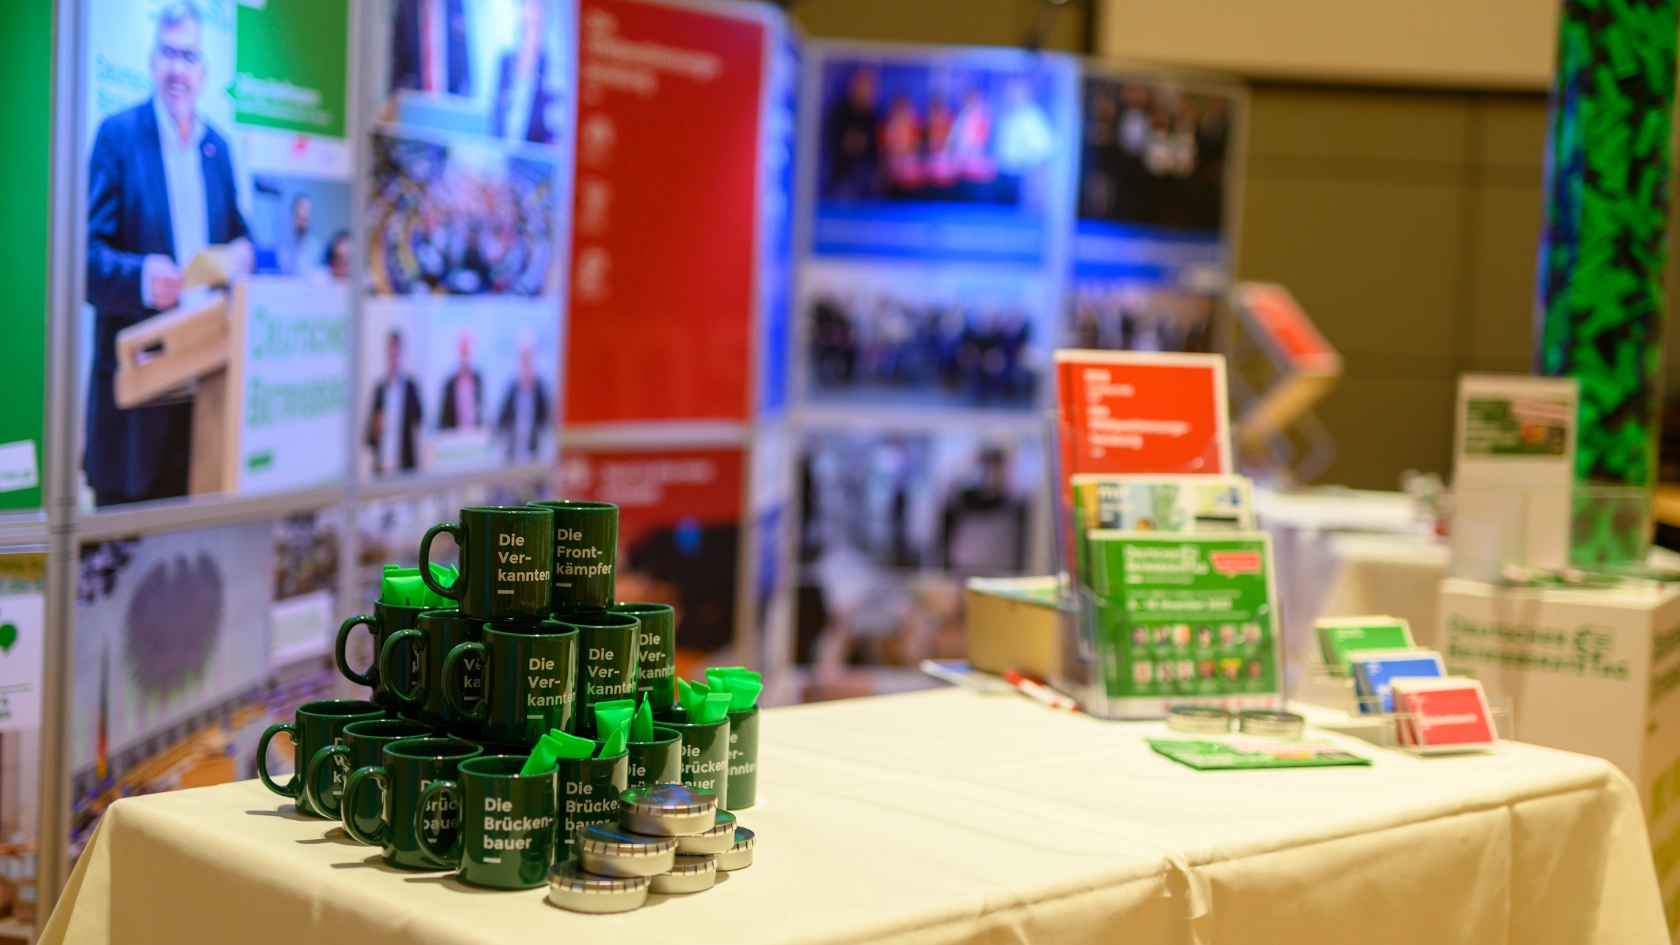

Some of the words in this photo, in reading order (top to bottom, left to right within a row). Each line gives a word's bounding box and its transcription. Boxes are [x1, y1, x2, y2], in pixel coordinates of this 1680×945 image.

[499, 533, 525, 547] Die
[556, 528, 583, 541] Die
[498, 551, 532, 564] Ver-
[556, 546, 603, 559] Front-
[497, 568, 550, 582] kannten
[556, 562, 613, 578] kämpfer
[638, 632, 661, 646] Die
[588, 648, 615, 661] Die
[638, 650, 666, 663] Ver-
[528, 657, 555, 671] Die
[587, 665, 620, 678] Ver-
[527, 675, 561, 689] Ver-
[565, 781, 593, 795] Die
[484, 797, 513, 812] Die
[483, 815, 554, 831] Brücken-
[483, 834, 532, 850] bauer
